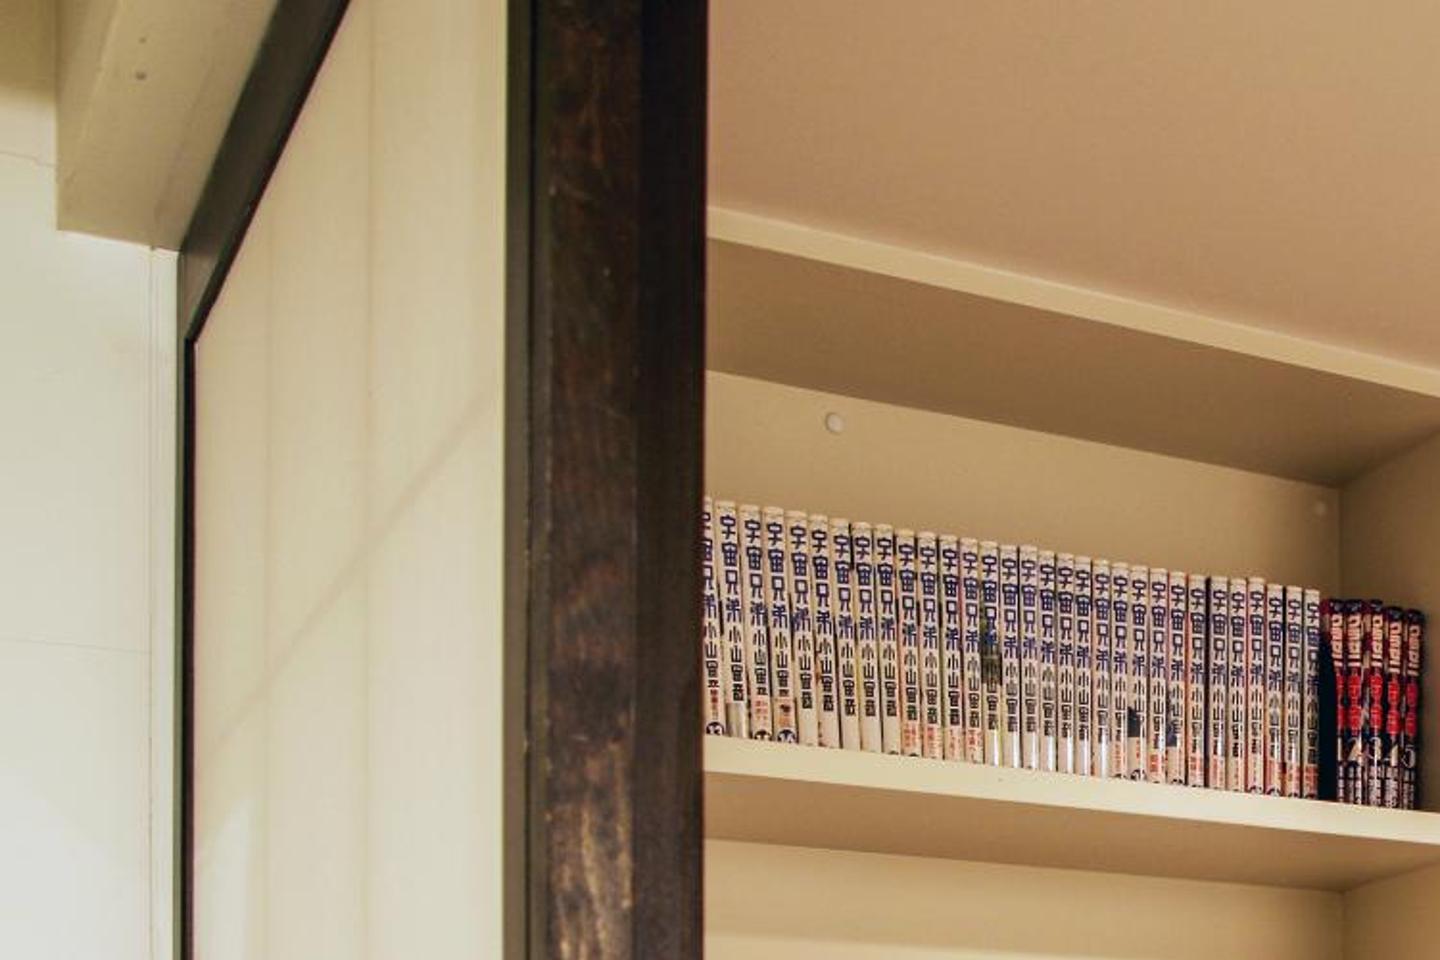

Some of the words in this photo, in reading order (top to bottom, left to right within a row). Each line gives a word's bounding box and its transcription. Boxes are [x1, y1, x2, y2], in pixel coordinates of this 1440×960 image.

[720, 514, 741, 622] 宇宙兄弟
[745, 519, 768, 626] 宇宙兄弟
[767, 523, 788, 628] 宇宙兄弟
[790, 525, 811, 631] 宇宙兄弟
[812, 529, 832, 635] 宇宙兄弟
[834, 534, 854, 640] 宇宙兄弟
[855, 536, 875, 640] 宇宙兄弟
[877, 537, 896, 641] 宇宙兄弟
[898, 544, 917, 648] 宇宙兄弟
[920, 546, 939, 649] 宇宙兄弟
[942, 548, 960, 651] 宇宙兄弟
[962, 552, 981, 653] 宇宙兄弟
[982, 555, 999, 655] 宇宙兄弟
[1002, 558, 1020, 660] 宇宙兄弟
[1021, 559, 1038, 660] 宇宙兄弟
[1040, 564, 1056, 664] 宇宙兄弟
[1058, 566, 1073, 667] 宇宙兄弟
[1076, 569, 1092, 670] 宇宙兄弟
[1095, 573, 1110, 673] 宇宙兄弟
[1113, 575, 1128, 676] 宇宙兄弟
[1132, 579, 1147, 678] 宇宙兄弟
[1152, 581, 1166, 681] 宇宙兄弟
[1171, 584, 1185, 682] 宇宙兄弟
[1191, 588, 1204, 686] 宇宙兄弟
[1212, 589, 1226, 687] 宇宙兄弟
[1231, 591, 1246, 688] 宇宙兄弟
[1250, 591, 1265, 687] 宇宙兄弟
